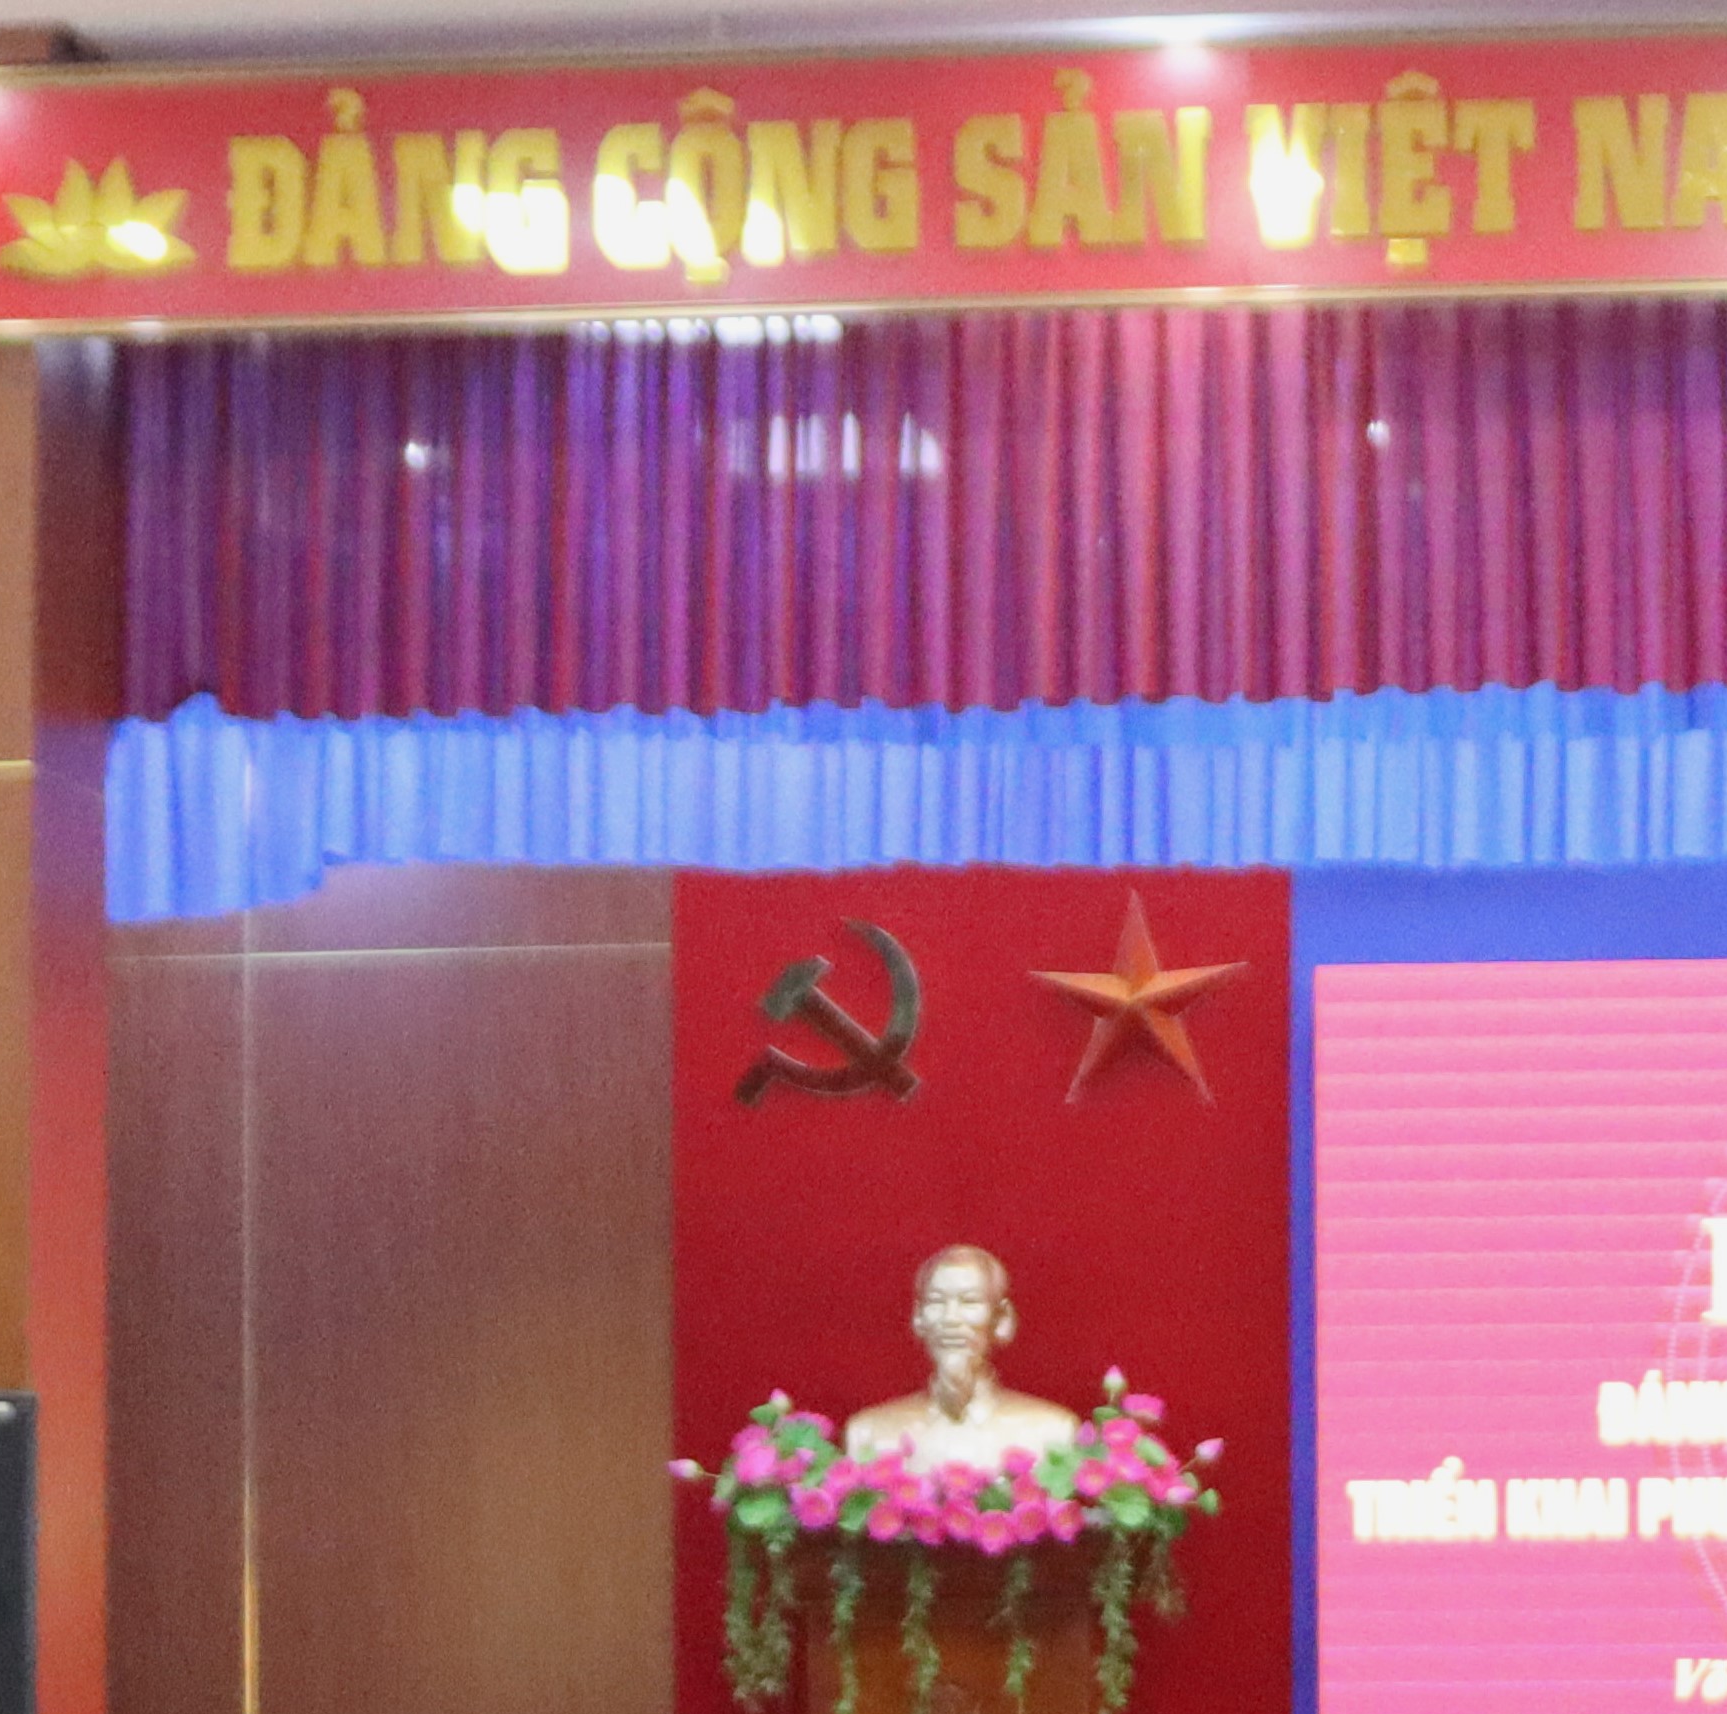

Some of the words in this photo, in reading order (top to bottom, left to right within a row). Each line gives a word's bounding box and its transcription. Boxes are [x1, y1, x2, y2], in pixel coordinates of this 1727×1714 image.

[226, 86, 570, 276] ĐẢNG
[592, 86, 920, 284] CỘNG
[953, 66, 1212, 252] SẢN
[1242, 70, 1536, 266] VIỆT
[1346, 1456, 1496, 1540] TRIỂN
[1507, 1477, 1628, 1539] KHAI
